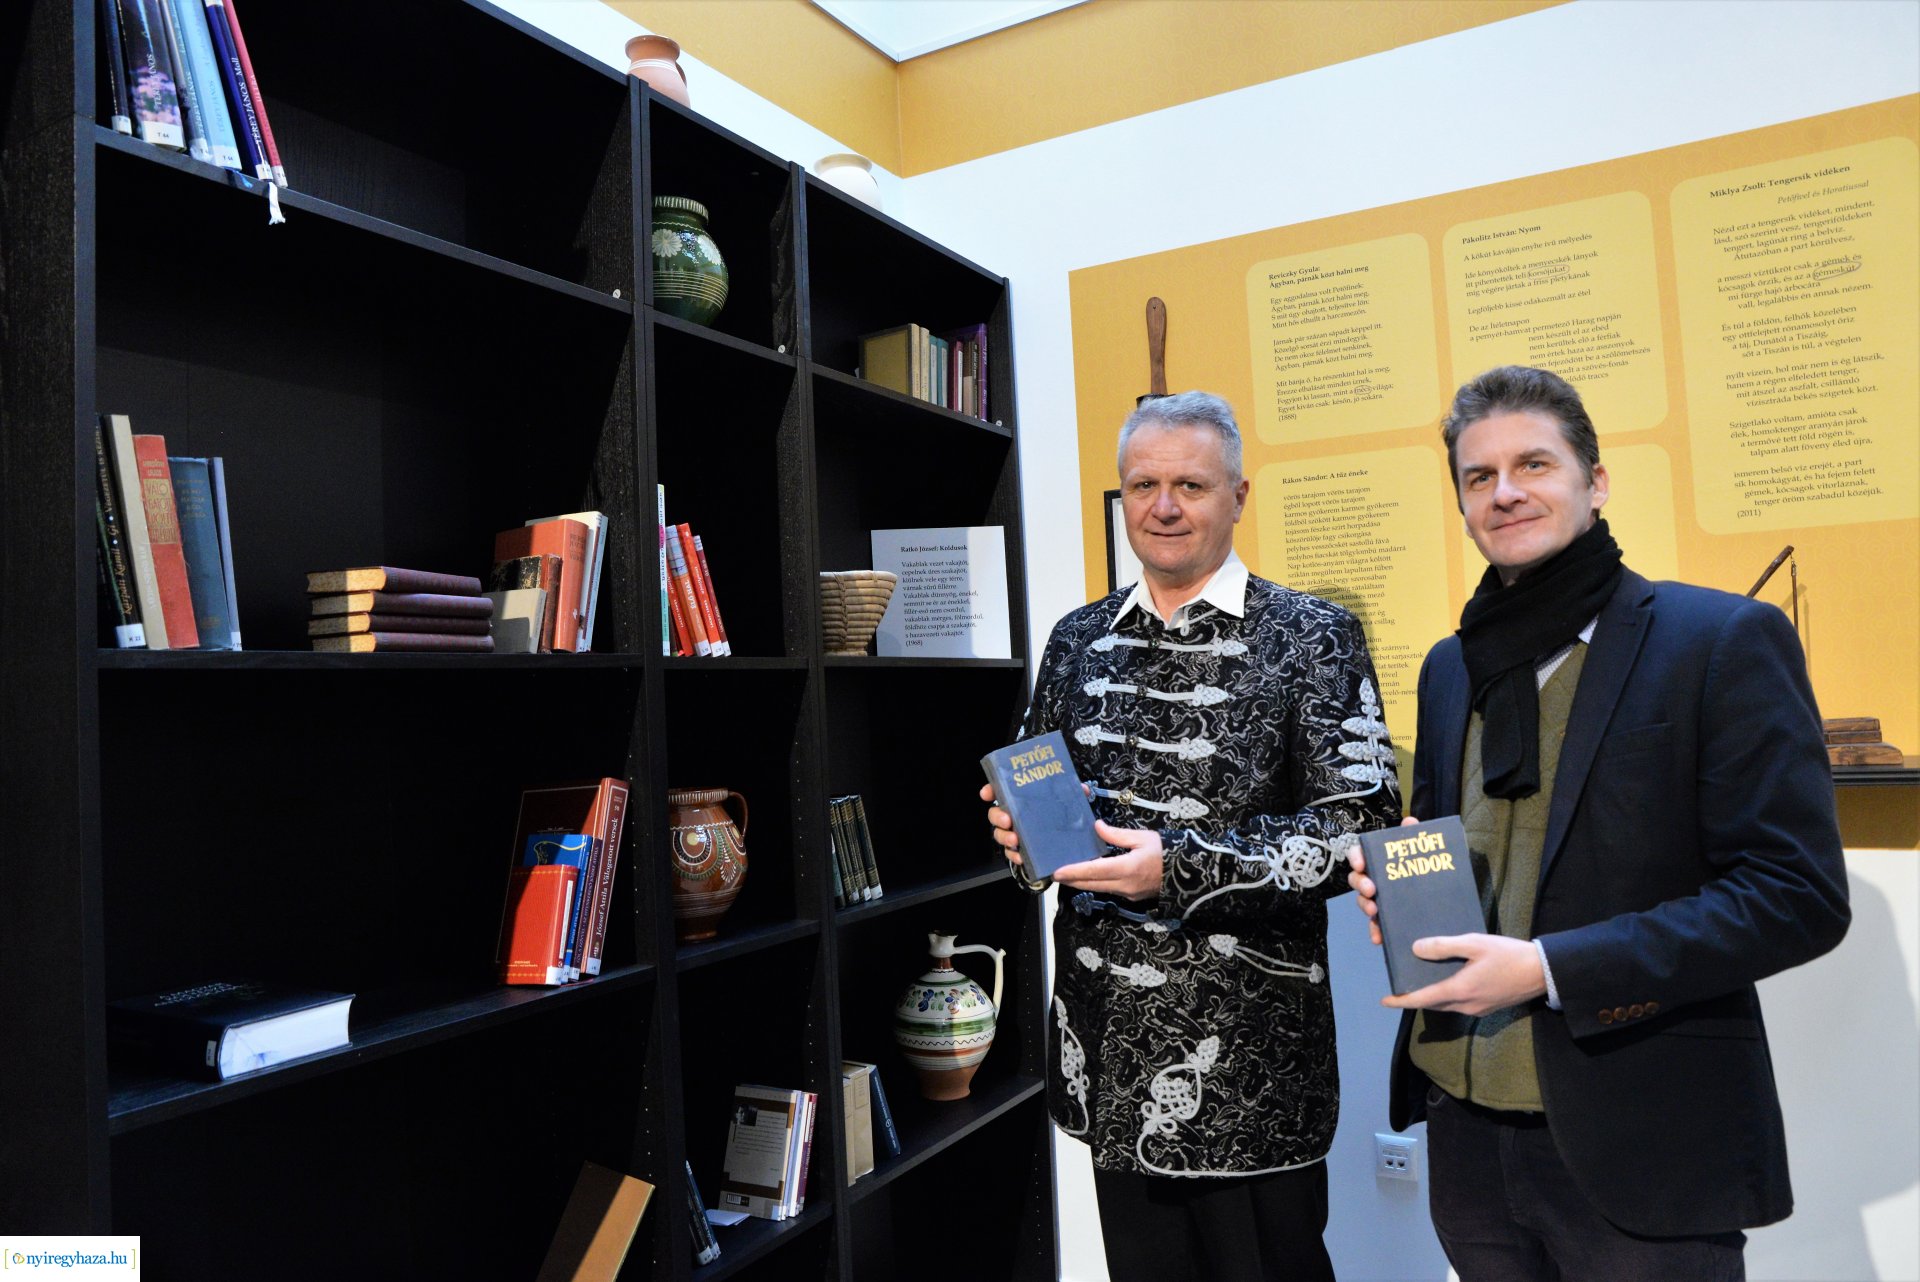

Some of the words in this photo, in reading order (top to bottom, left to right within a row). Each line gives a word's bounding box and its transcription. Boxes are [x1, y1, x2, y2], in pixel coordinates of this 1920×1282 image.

[231, 57, 243, 76] Moll
[238, 82, 252, 113] JÁNOS
[247, 112, 262, 143] TÉREY
[1710, 187, 1740, 198] Miklya
[1769, 172, 1811, 186] Tengersík
[1814, 166, 1850, 178] vidéken
[1462, 234, 1491, 244] Pákolitz
[1518, 226, 1541, 236] Nyom
[1268, 269, 1297, 280] Reviczky
[1282, 476, 1302, 484] Rákos
[1348, 469, 1368, 477] éneke
[112, 548, 125, 576] Kamil
[1010, 744, 1055, 770] PETŐFI
[1014, 760, 1064, 787] SÁNDOR
[610, 818, 618, 842] versek
[1384, 831, 1445, 859] PETŐFI
[602, 844, 614, 885] Válogatott
[1386, 852, 1456, 880] SÁNDOR
[599, 888, 608, 910] Attila
[595, 911, 604, 936] József
